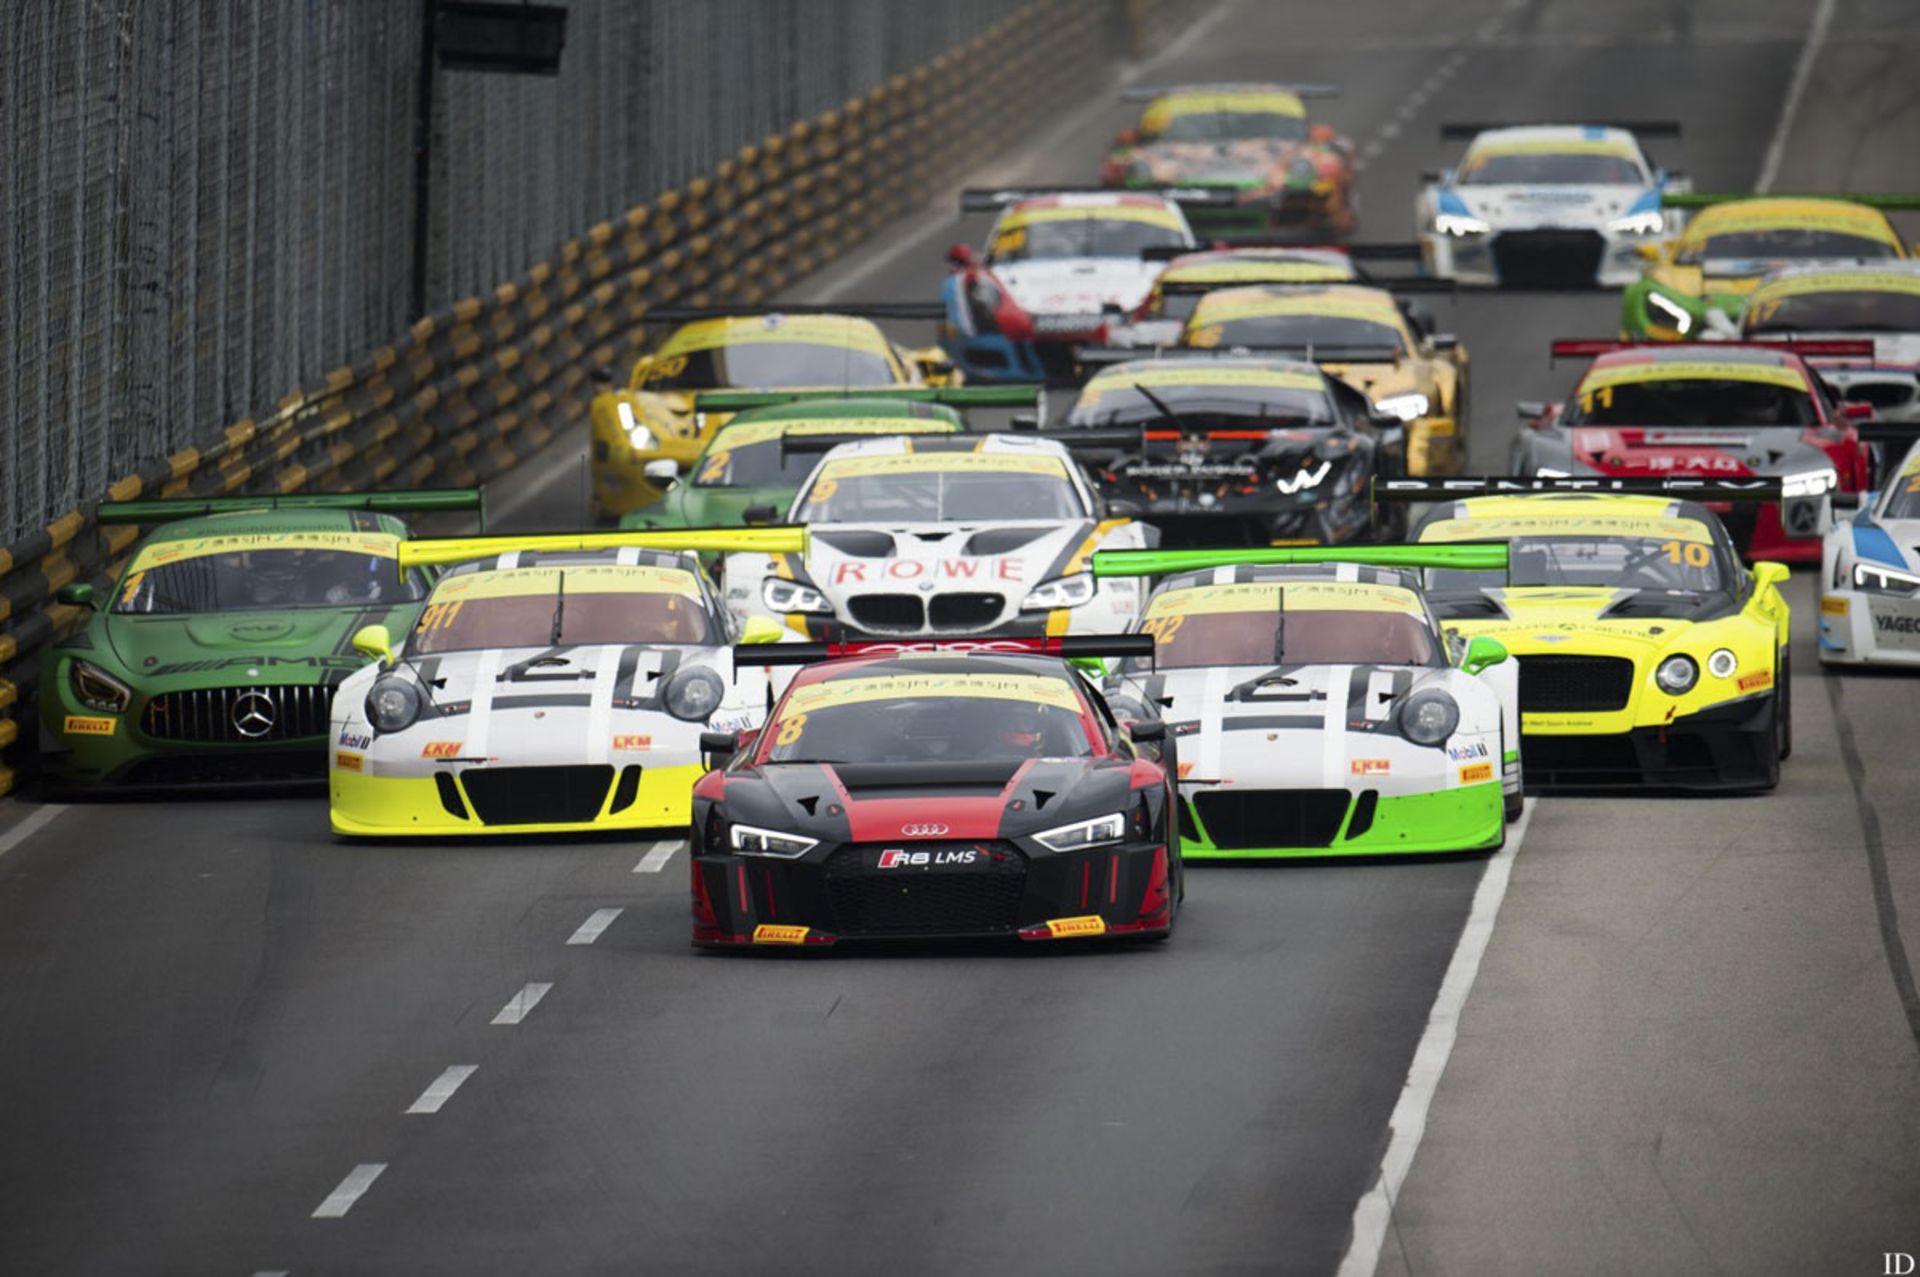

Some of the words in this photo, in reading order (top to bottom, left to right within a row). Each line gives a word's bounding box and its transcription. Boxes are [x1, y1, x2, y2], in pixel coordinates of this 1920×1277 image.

[1580, 386, 1613, 413] 11
[701, 450, 731, 480] 2
[808, 479, 839, 503] 9
[1661, 540, 1711, 567] 10
[835, 558, 1024, 585] ROWE
[123, 571, 145, 604] 1
[416, 600, 464, 634] 911
[776, 714, 807, 746] 8
[422, 741, 463, 757] LKM
[882, 850, 930, 867] R8
[935, 851, 976, 864] LMS
